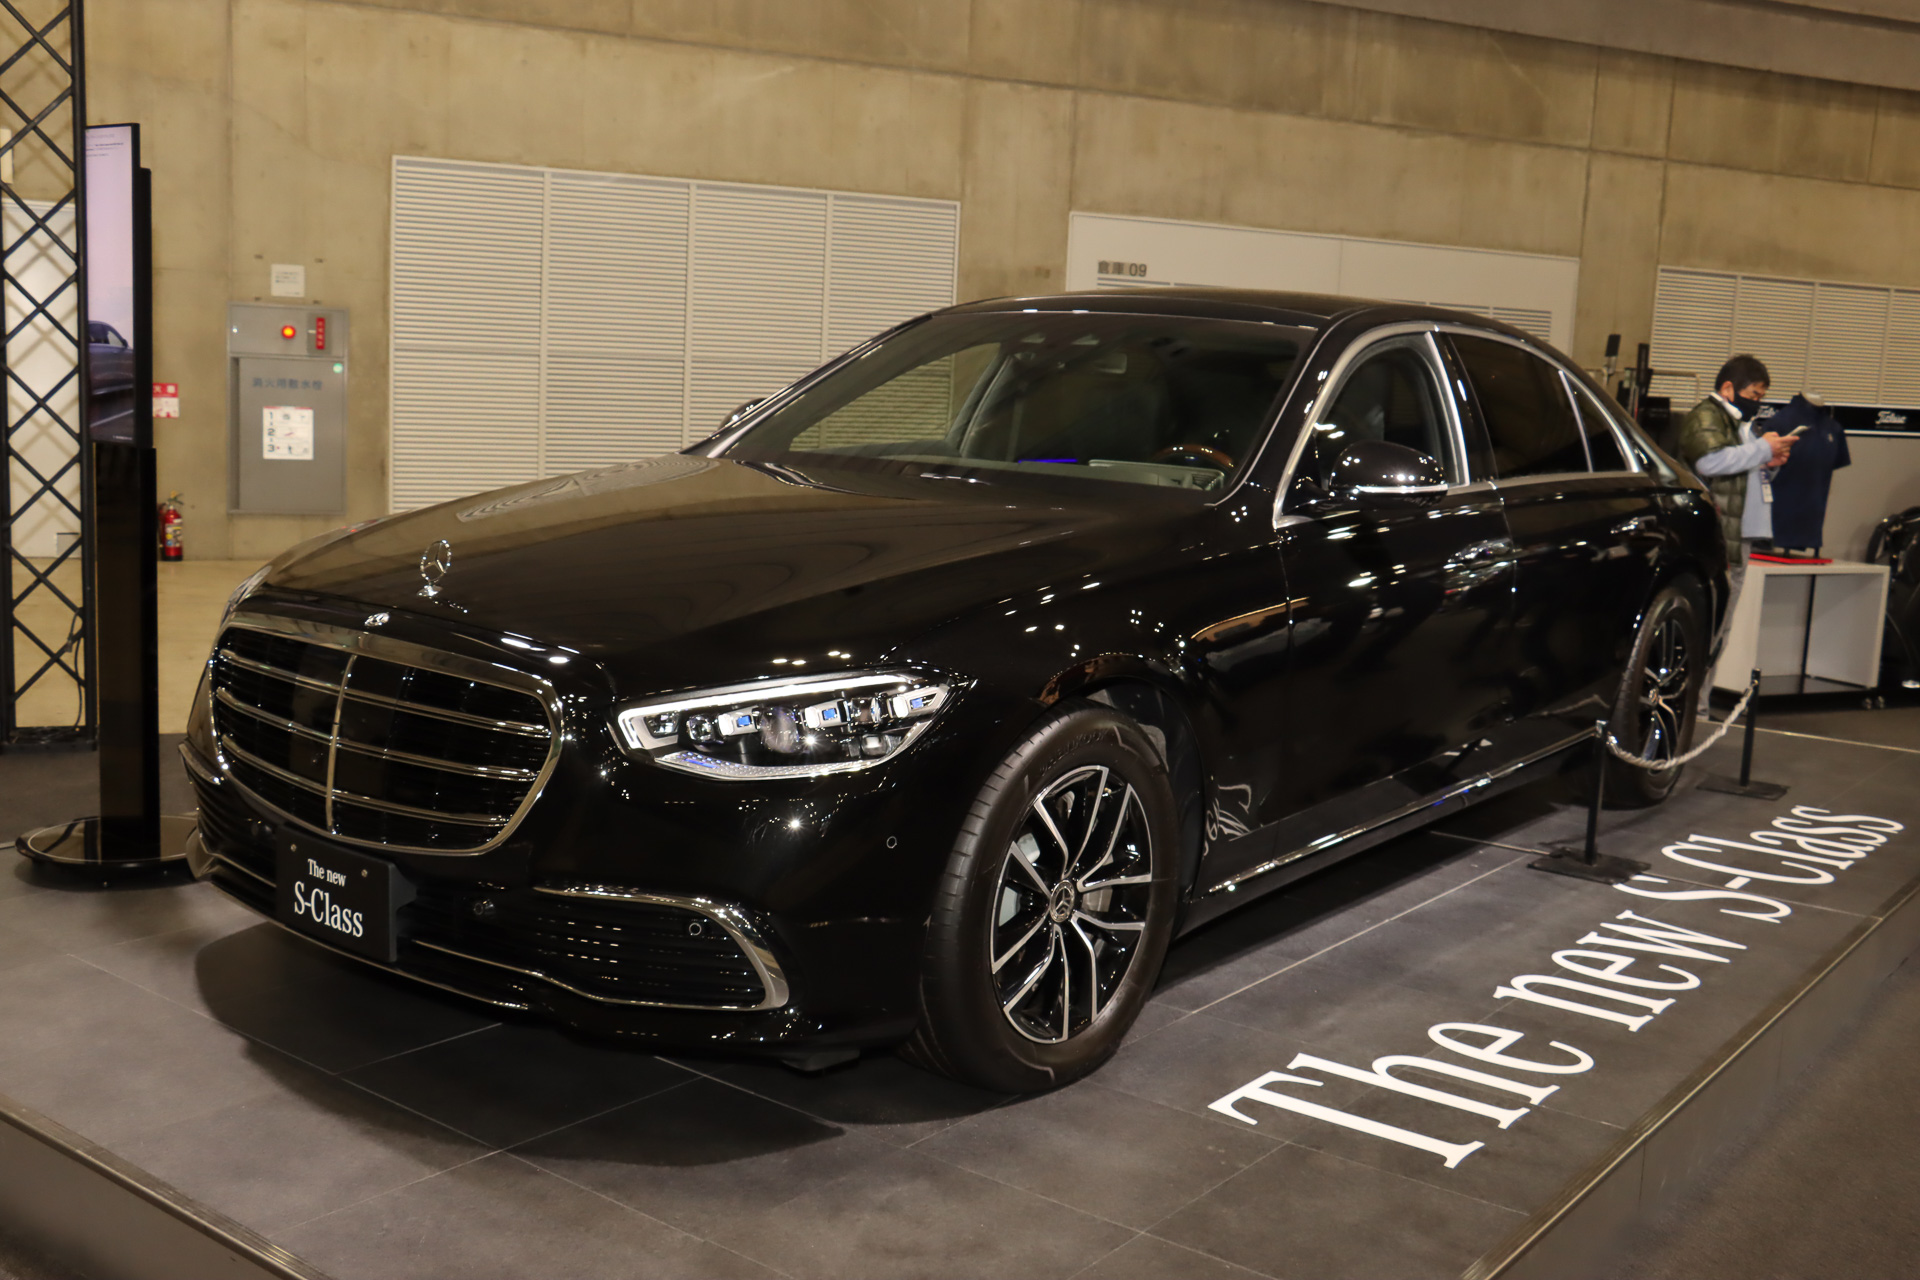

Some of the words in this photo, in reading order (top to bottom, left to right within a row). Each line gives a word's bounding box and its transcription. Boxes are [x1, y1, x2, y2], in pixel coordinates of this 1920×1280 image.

[1129, 263, 1147, 277] 09
[267, 428, 276, 436] 2
[267, 444, 275, 452] 3
[307, 858, 325, 880] The
[326, 869, 347, 887] new
[1613, 804, 1905, 923] S-Class
[294, 880, 364, 938] S-Class
[1492, 908, 1748, 1033] new
[1207, 1020, 1596, 1169] The
